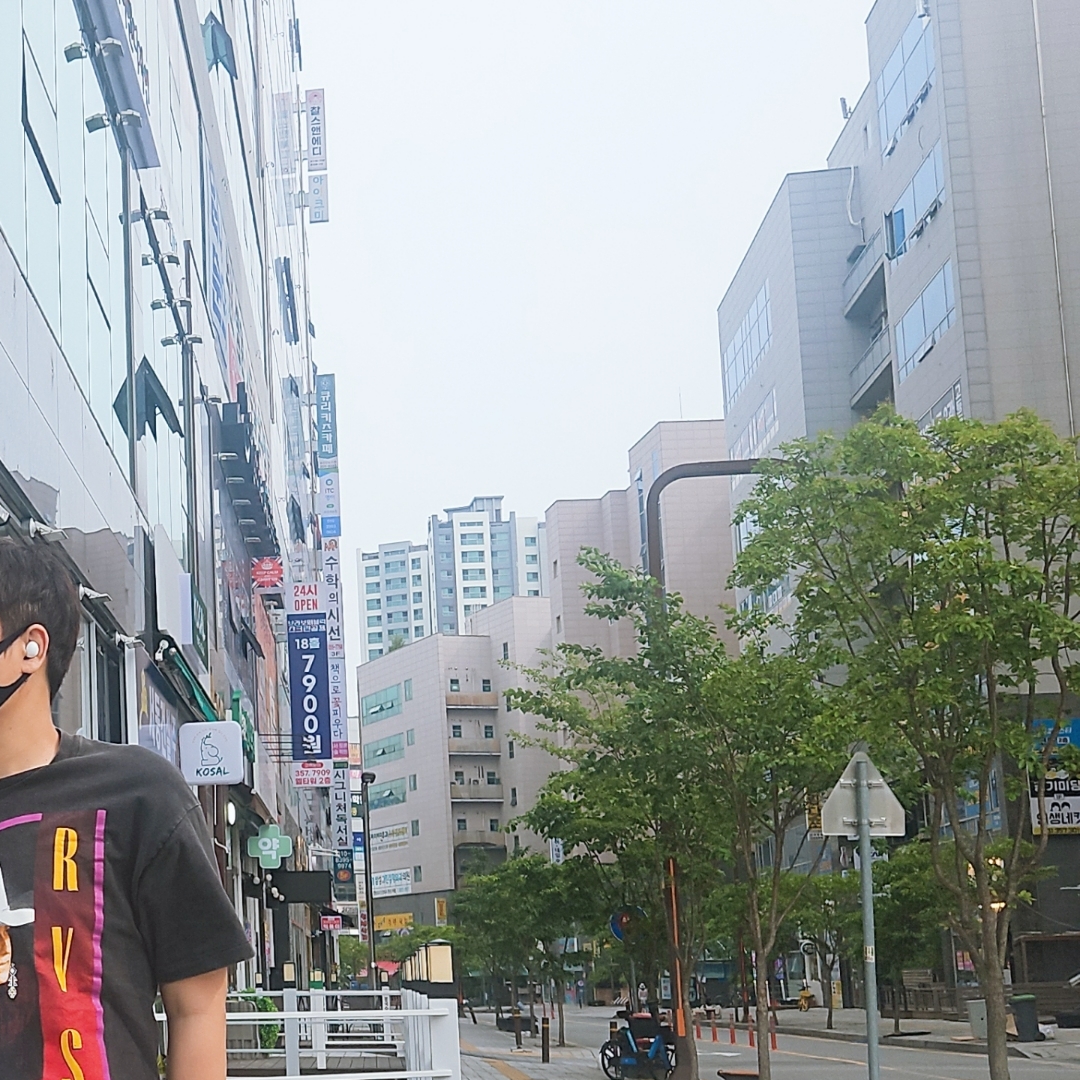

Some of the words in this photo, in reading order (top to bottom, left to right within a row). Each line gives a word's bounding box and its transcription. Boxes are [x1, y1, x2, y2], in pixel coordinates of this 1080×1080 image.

[293, 584, 318, 597] 24시
[325, 556, 341, 641] 수학의시선
[294, 599, 318, 611] OPEN
[196, 766, 230, 778] KOSAL
[334, 769, 348, 847] 시그니처독서실
[257, 837, 280, 860] 약
